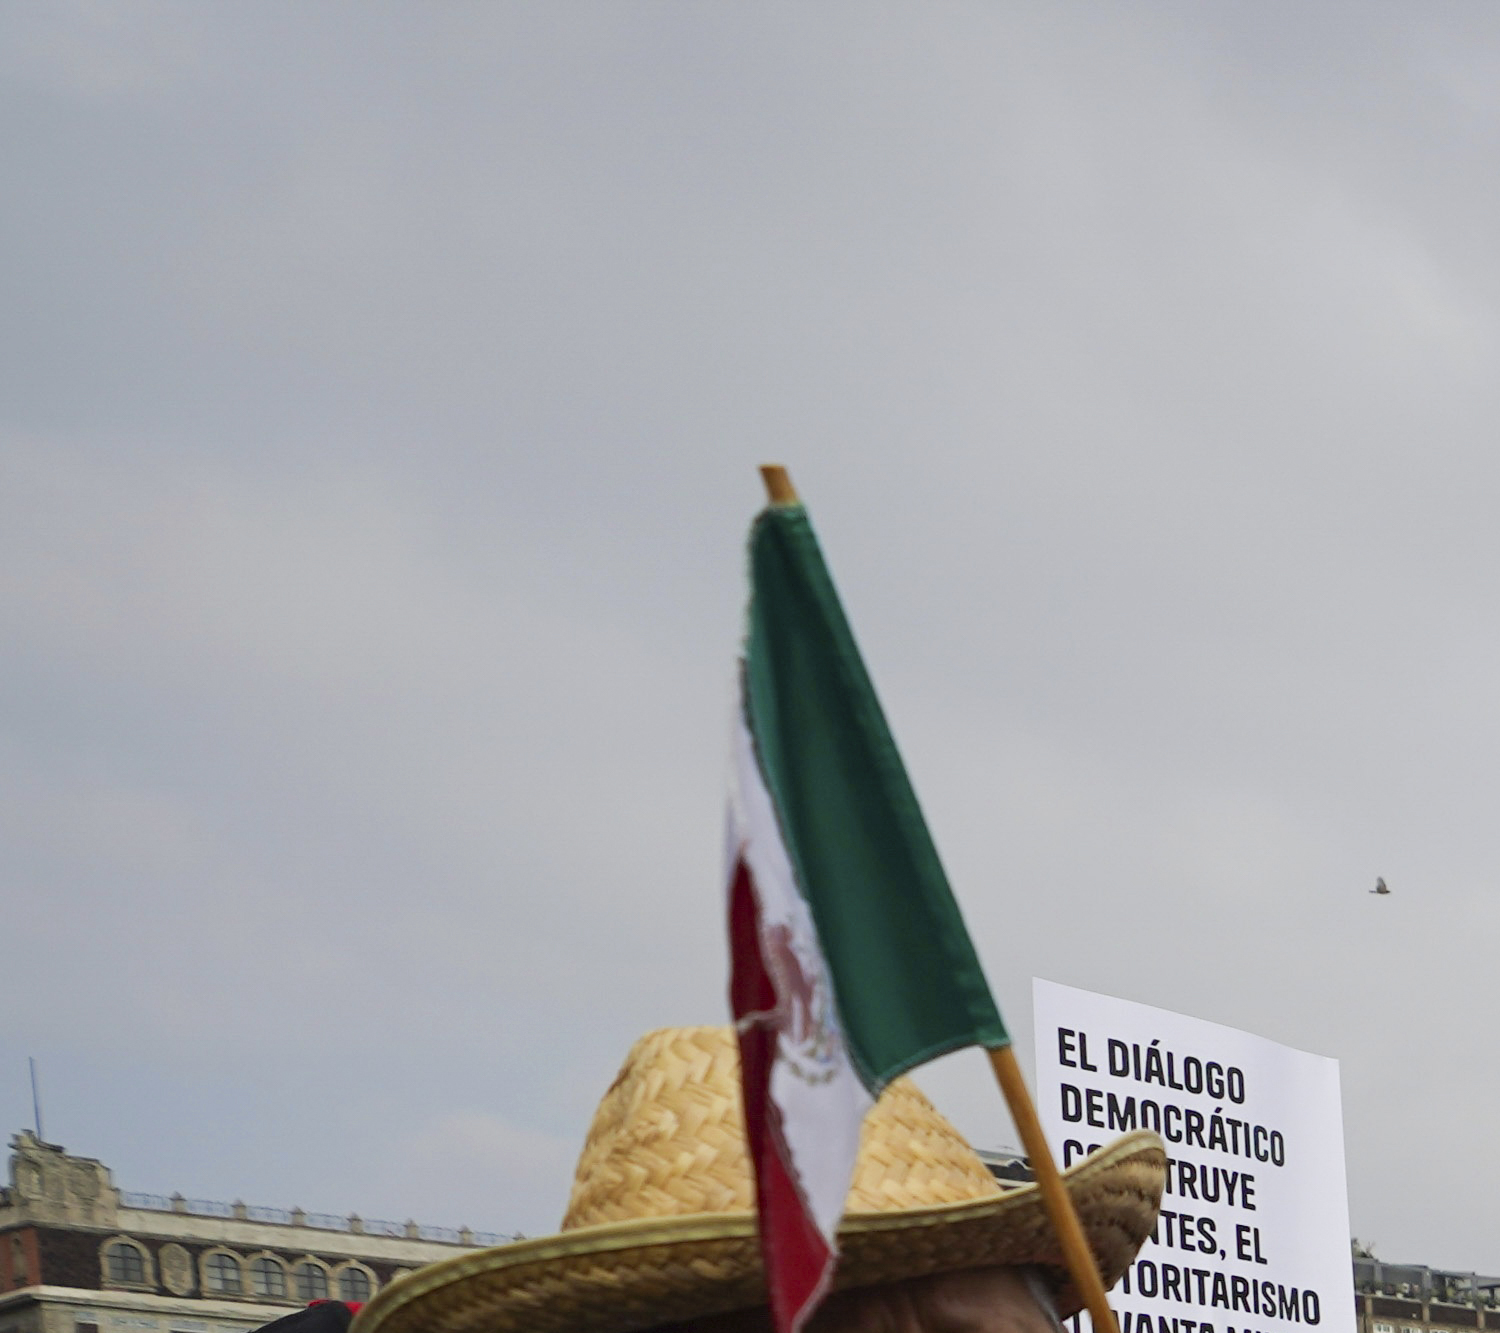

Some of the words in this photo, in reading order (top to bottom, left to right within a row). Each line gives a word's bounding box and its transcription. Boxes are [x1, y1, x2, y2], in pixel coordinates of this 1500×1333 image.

[1057, 1027, 1097, 1073] EL
[1108, 1039, 1245, 1105] DIÁLOGO
[1060, 1083, 1285, 1168] DEMOCRÁTICO
[1063, 1139, 1256, 1211] CTRUYE
[1235, 1224, 1267, 1265] EL
[1122, 1260, 1321, 1326] TORITARISMO
